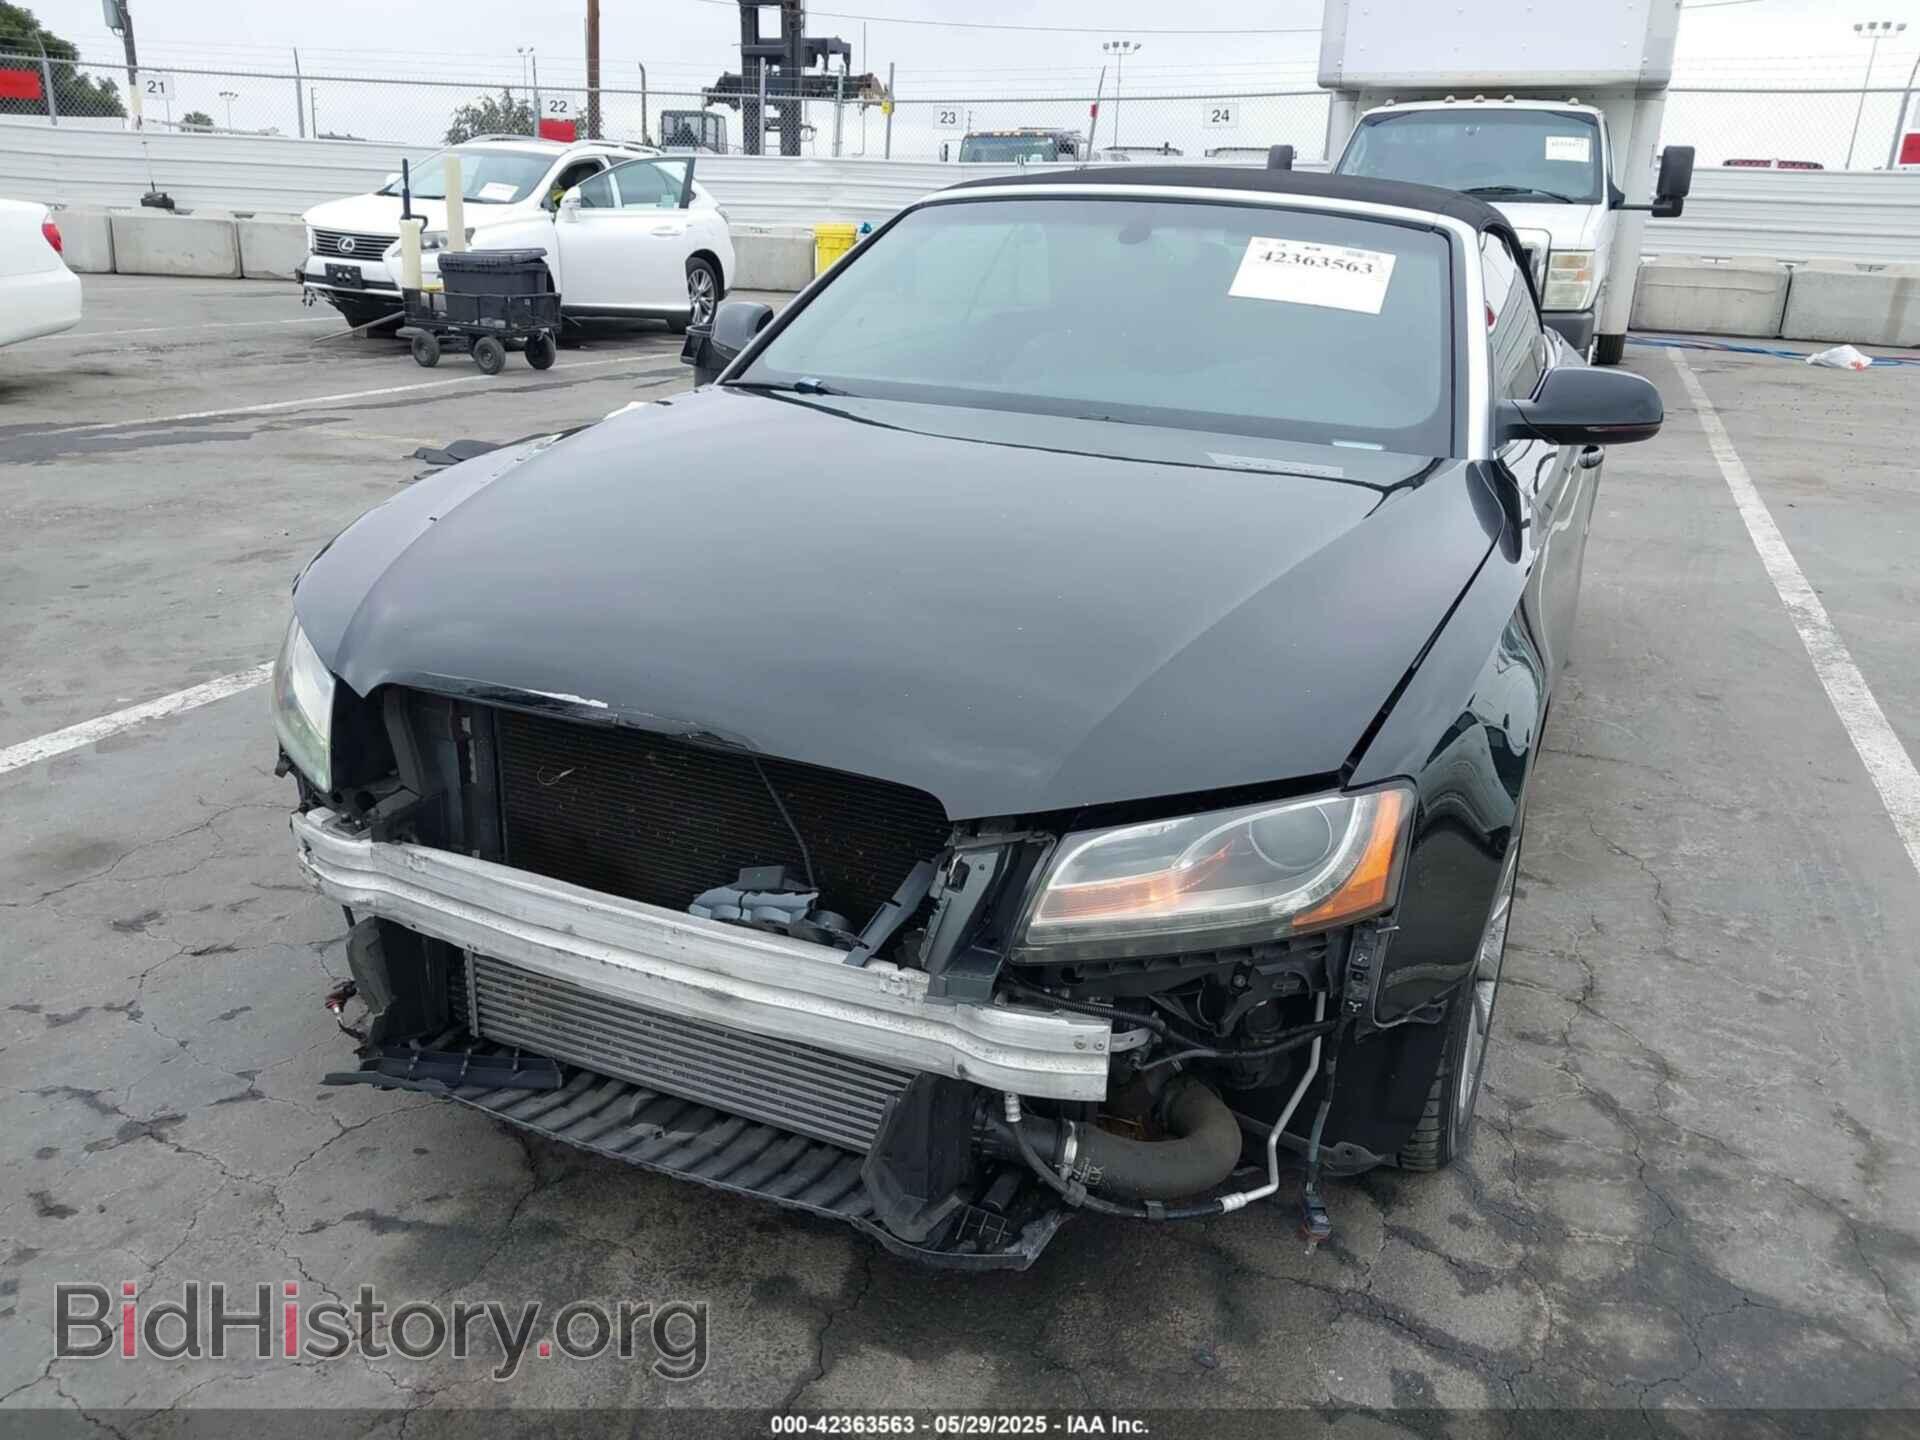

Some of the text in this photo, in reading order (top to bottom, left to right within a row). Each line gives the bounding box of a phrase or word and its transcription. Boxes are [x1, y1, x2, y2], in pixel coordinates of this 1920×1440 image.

[147, 80, 165, 94] 21
[550, 100, 568, 113] 22
[940, 111, 956, 124] 23
[1211, 109, 1230, 122] 24
[1259, 251, 1374, 274] 42363563
